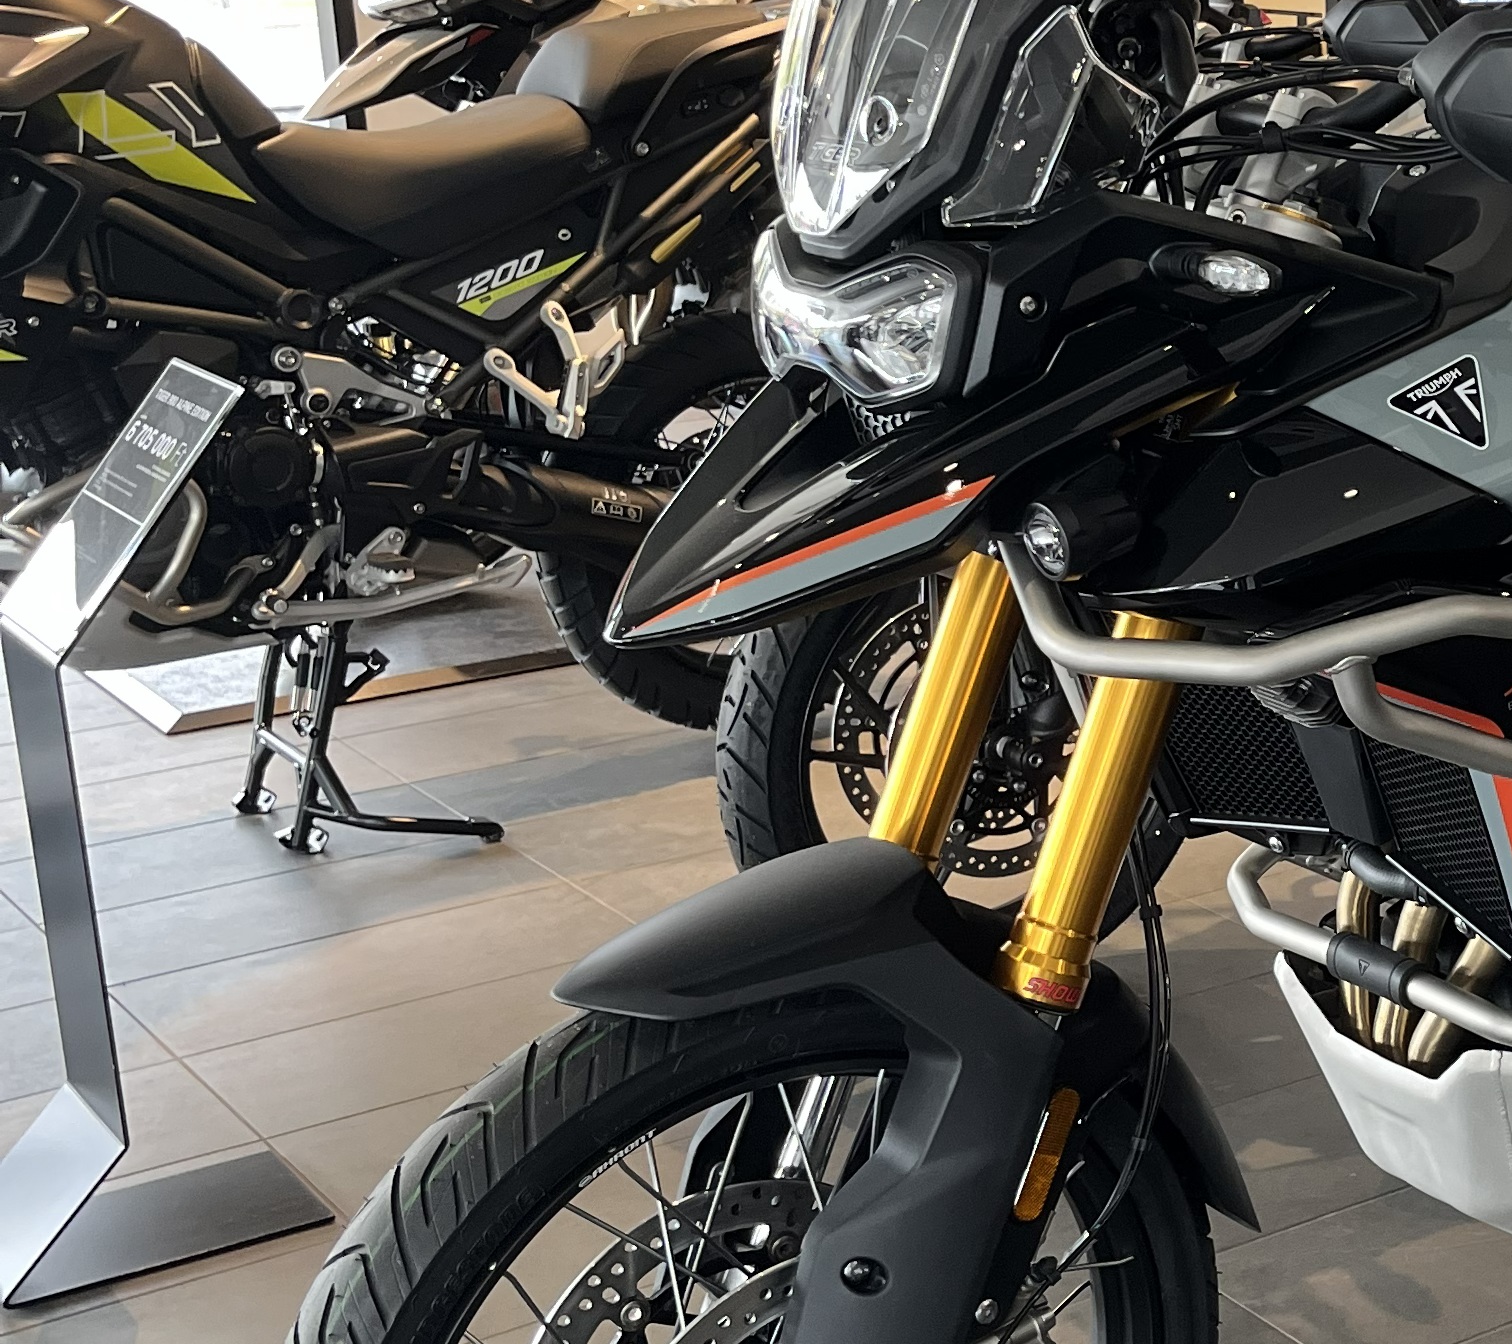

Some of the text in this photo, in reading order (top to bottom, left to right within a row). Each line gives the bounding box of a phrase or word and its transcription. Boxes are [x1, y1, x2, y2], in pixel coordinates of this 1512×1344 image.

[456, 248, 545, 304] 1200
[1406, 366, 1463, 403] TRIUMPH
[124, 419, 187, 467] 6 705 000 Ft
